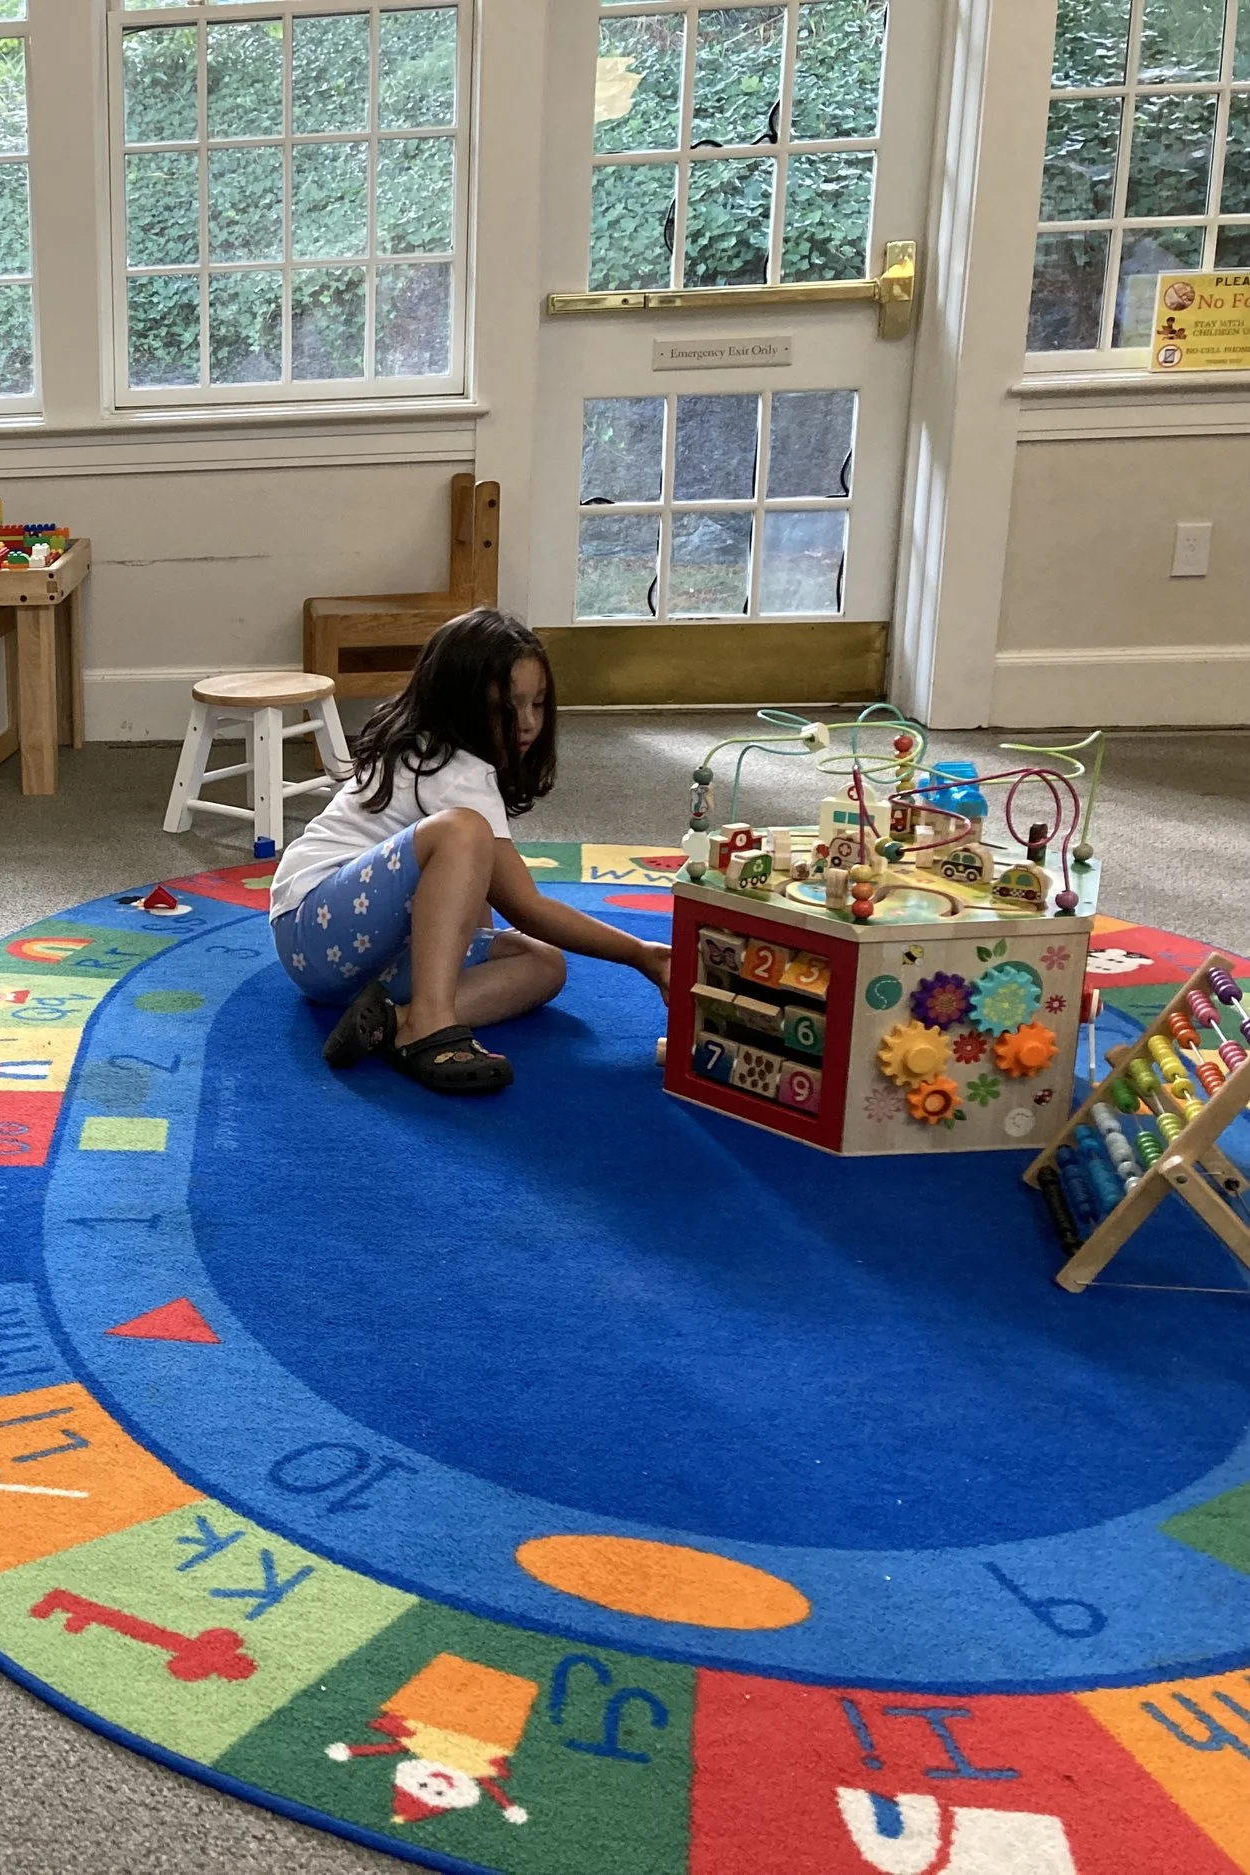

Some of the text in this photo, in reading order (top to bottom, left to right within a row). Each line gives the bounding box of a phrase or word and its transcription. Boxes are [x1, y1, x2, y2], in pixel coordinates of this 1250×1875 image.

[1197, 294, 1224, 310] No
[1192, 328, 1239, 337] CHILDREN
[1194, 319, 1245, 328] STAY WITH
[670, 344, 778, 360] Emergency Exit Only
[74, 947, 140, 970] Rr
[753, 950, 772, 978] 2
[799, 961, 819, 983] 3
[797, 1020, 815, 1046] 6
[706, 1044, 722, 1070] 7
[791, 1074, 811, 1101] 9
[270, 1441, 418, 1518] 10
